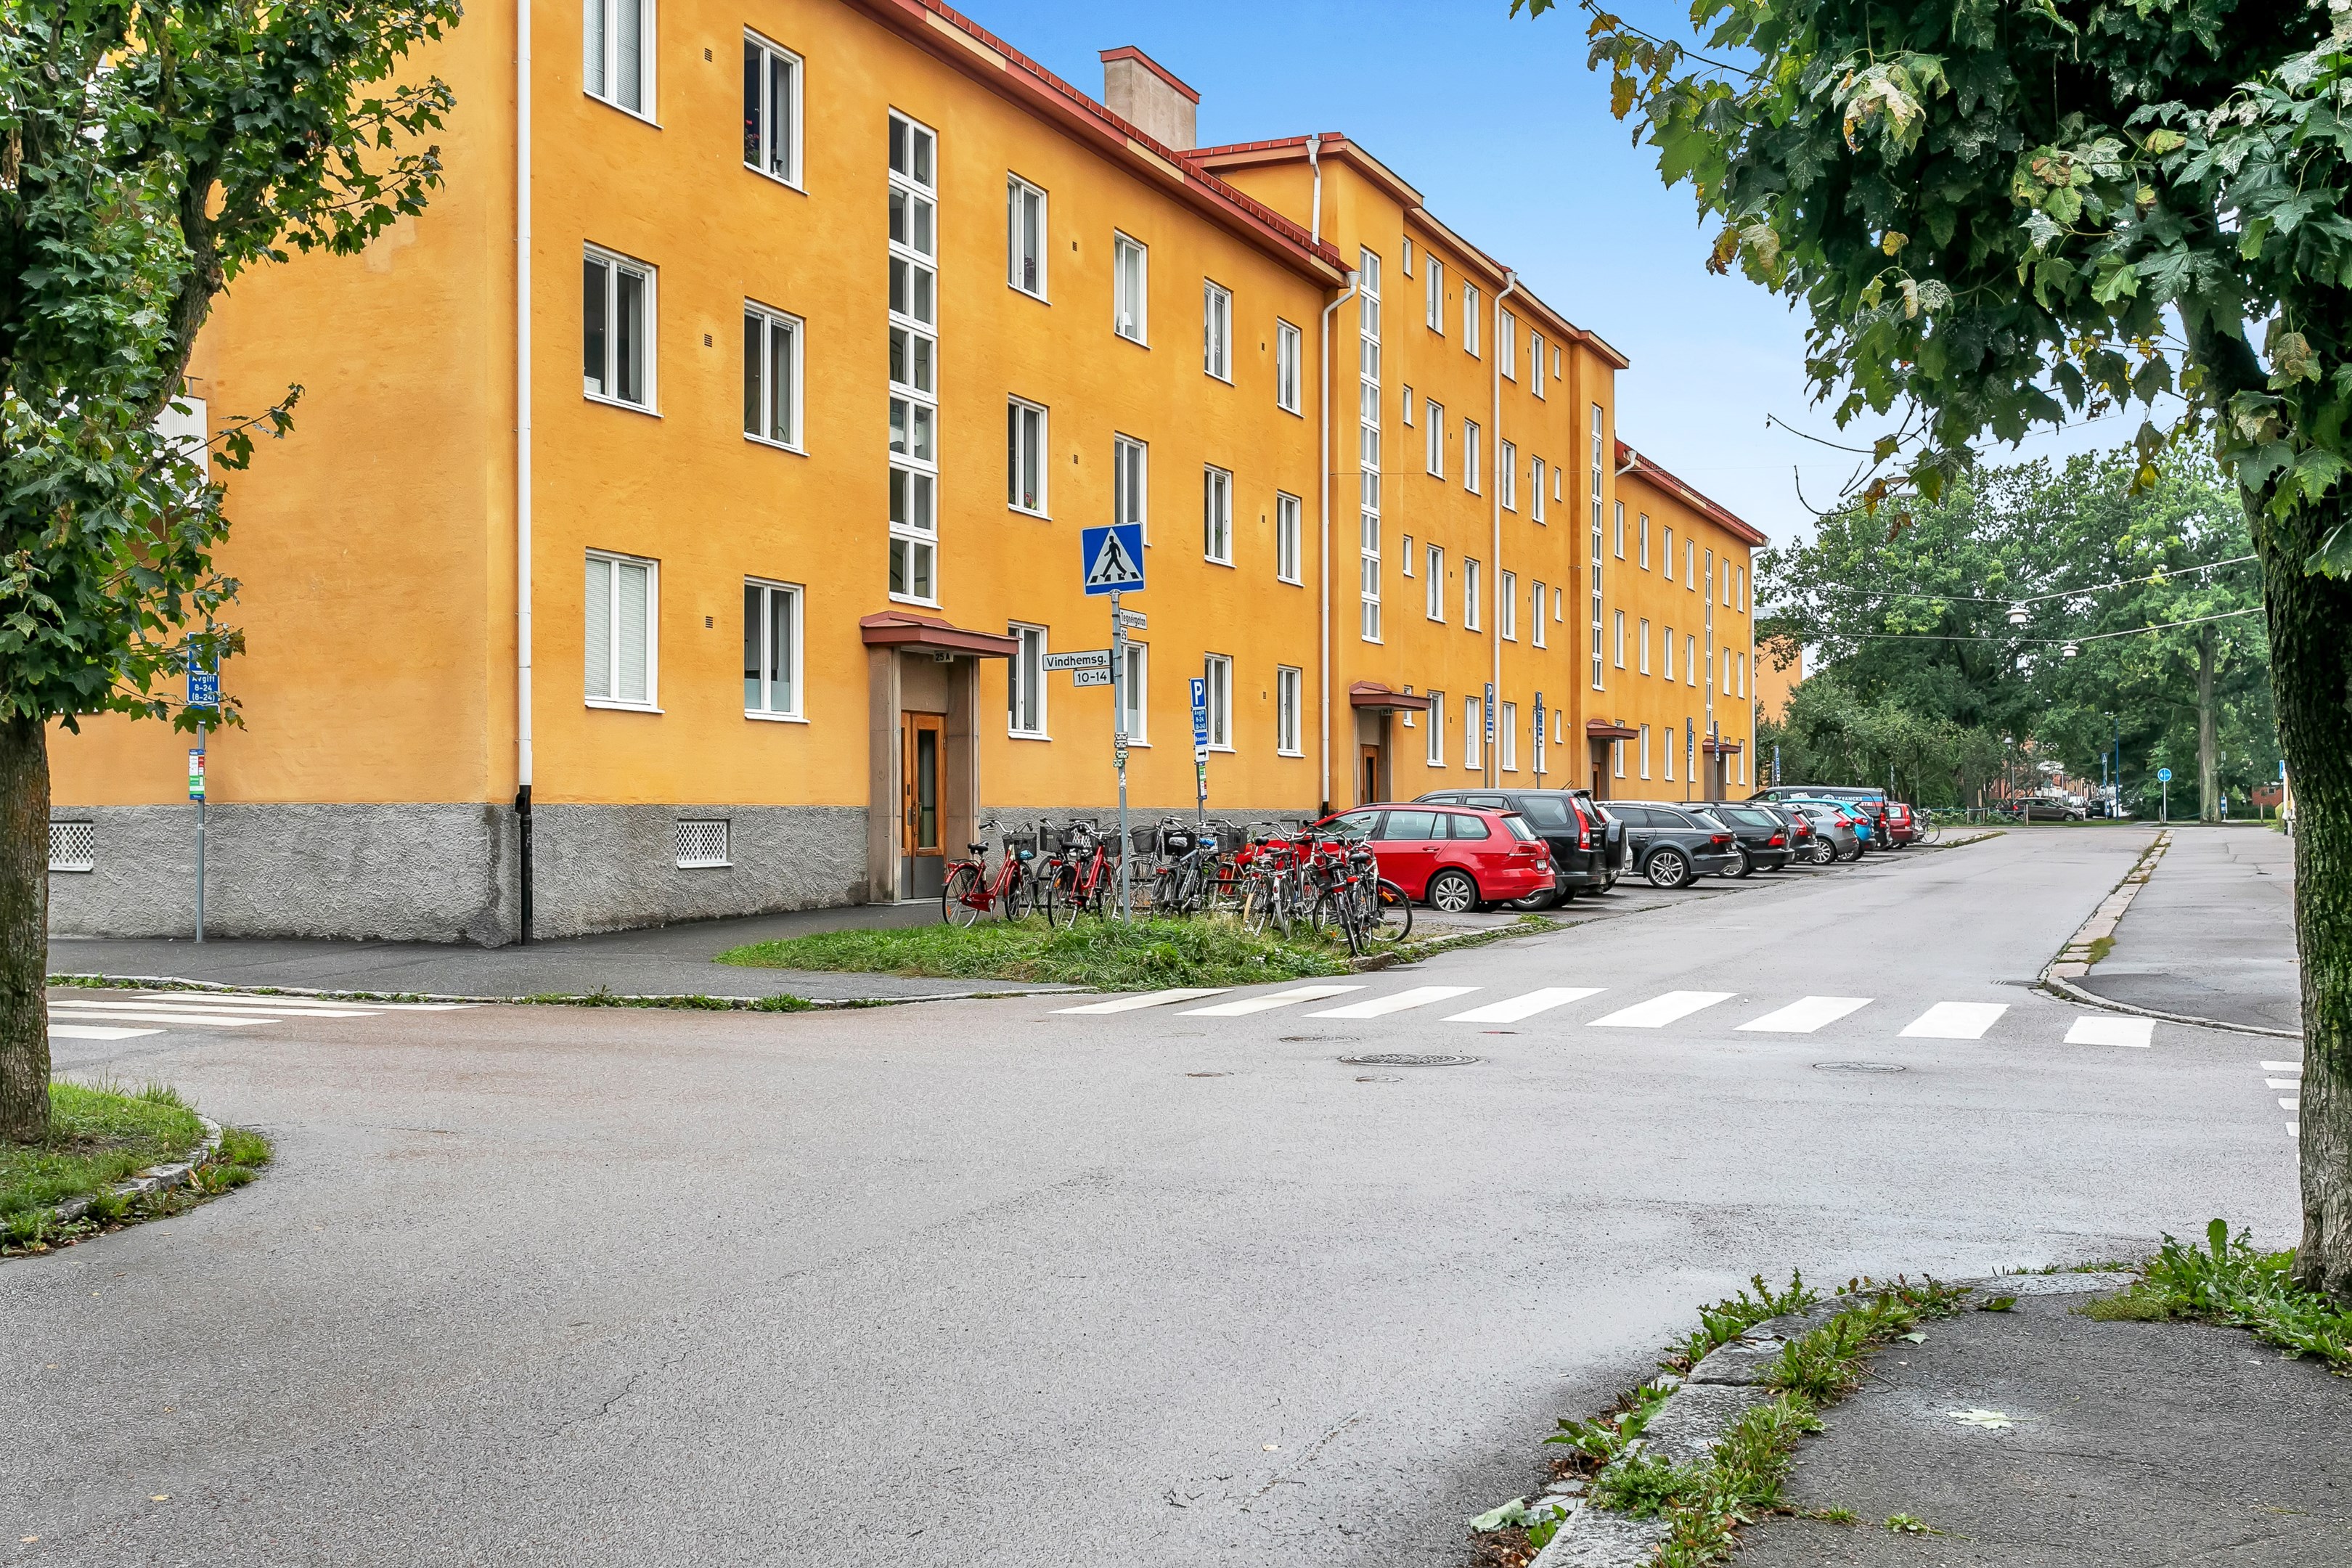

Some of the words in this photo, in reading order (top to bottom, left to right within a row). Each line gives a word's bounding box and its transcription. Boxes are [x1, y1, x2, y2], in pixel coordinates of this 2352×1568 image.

[1121, 612, 1146, 626] Tegnérgatan
[1122, 629, 1127, 640] 25
[1047, 655, 1106, 666] Vindhemsg.
[1077, 671, 1107, 682] 10-14
[192, 693, 215, 702] (8-24)
[1194, 681, 1203, 705] P
[1488, 685, 1493, 702] P
